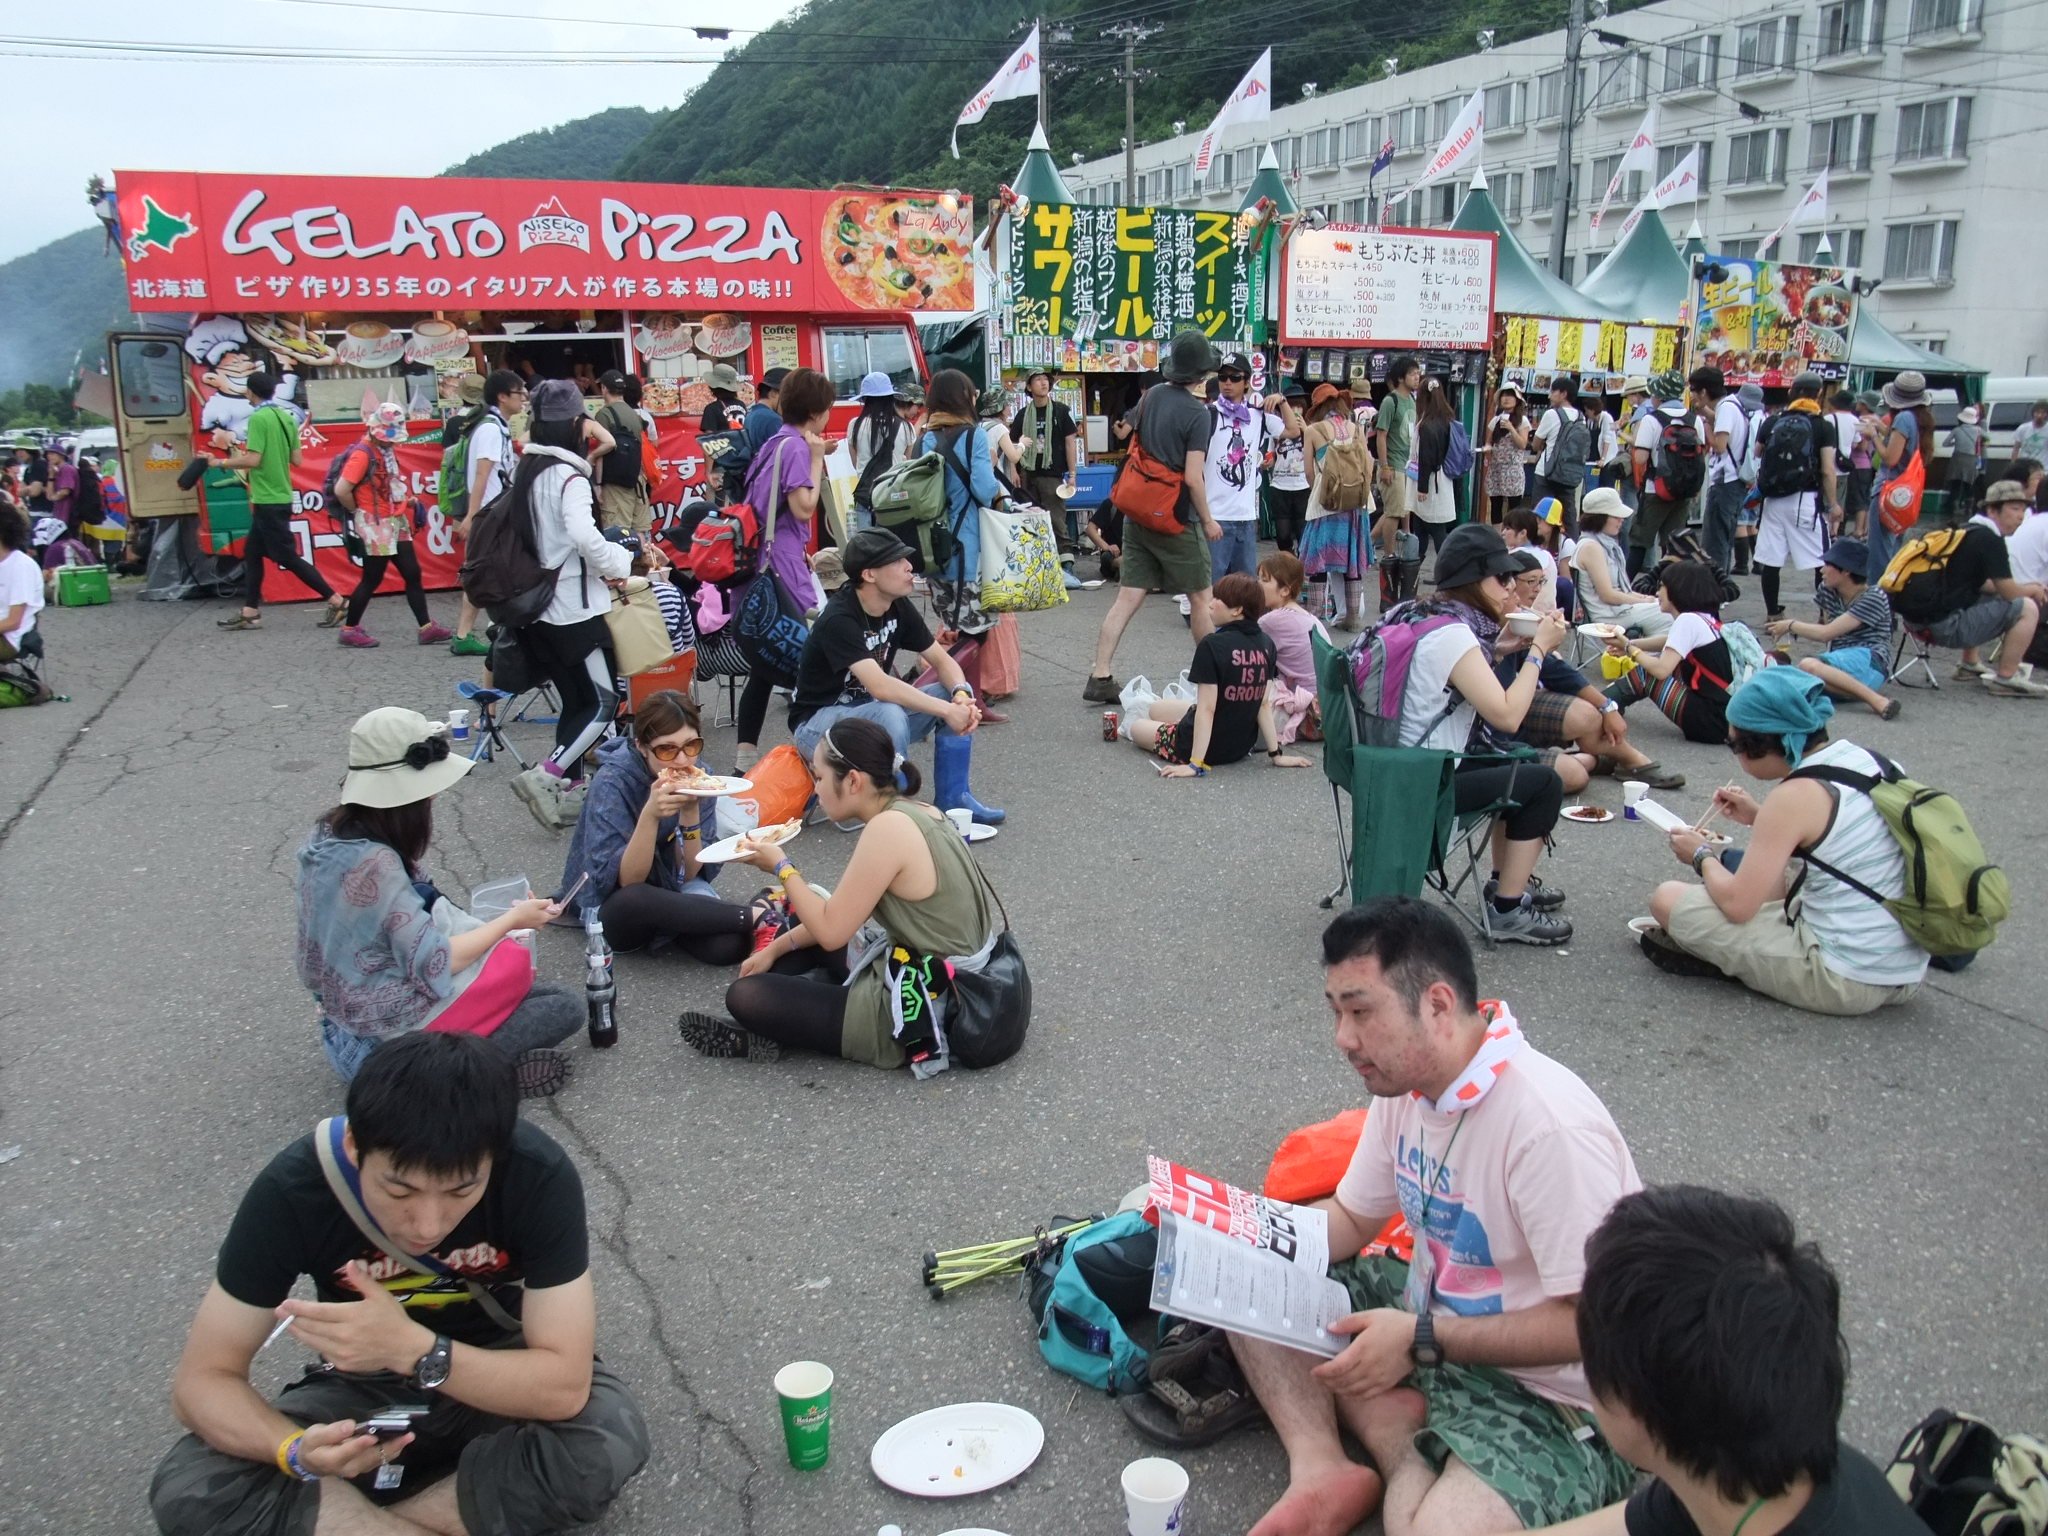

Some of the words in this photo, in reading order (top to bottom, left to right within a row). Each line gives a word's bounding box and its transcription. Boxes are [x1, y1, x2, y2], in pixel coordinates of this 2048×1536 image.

[222, 189, 505, 266] GELATO
[1358, 241, 1436, 266] もちぶた丼
[132, 278, 208, 300] 北海道
[1034, 205, 1073, 336] サワー
[1096, 207, 1118, 330] 越後のワイン
[1115, 207, 1154, 337] ビール
[1153, 211, 1174, 340] 新潟の本格焼酎
[1174, 213, 1196, 319] 新潟の梅酒
[1195, 212, 1231, 338] スイーツ
[1421, 271, 1460, 285] 生ビール
[1702, 267, 1774, 311] 生ビール
[762, 325, 796, 334] Coffee
[1419, 319, 1448, 329] コーヒー
[1241, 667, 1255, 684] IS
